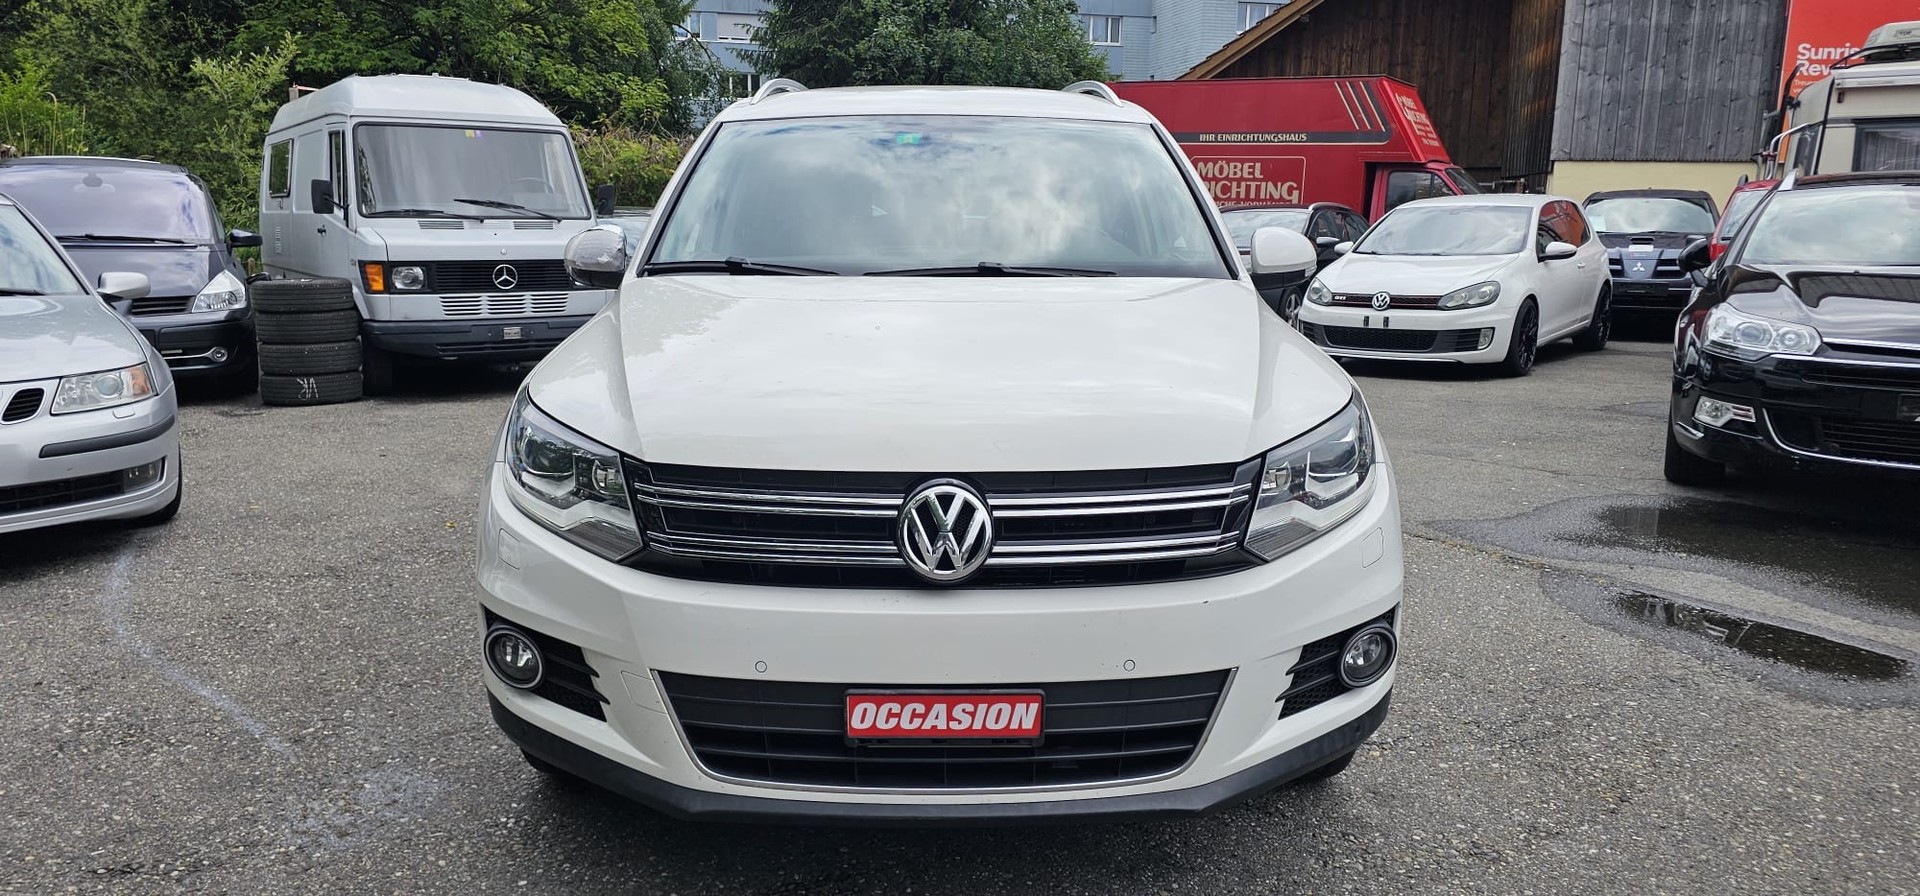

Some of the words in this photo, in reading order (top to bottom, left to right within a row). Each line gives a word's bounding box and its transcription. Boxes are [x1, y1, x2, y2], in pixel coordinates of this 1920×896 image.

[1797, 42, 1861, 60] Sunris
[1199, 133, 1216, 142] IHR
[1217, 133, 1307, 142] EINRICHTUNGSHAUS
[1197, 160, 1264, 179] MÖBEL
[1372, 292, 1390, 310] VW
[900, 483, 994, 582] VW
[850, 702, 1040, 731] OCCASION
